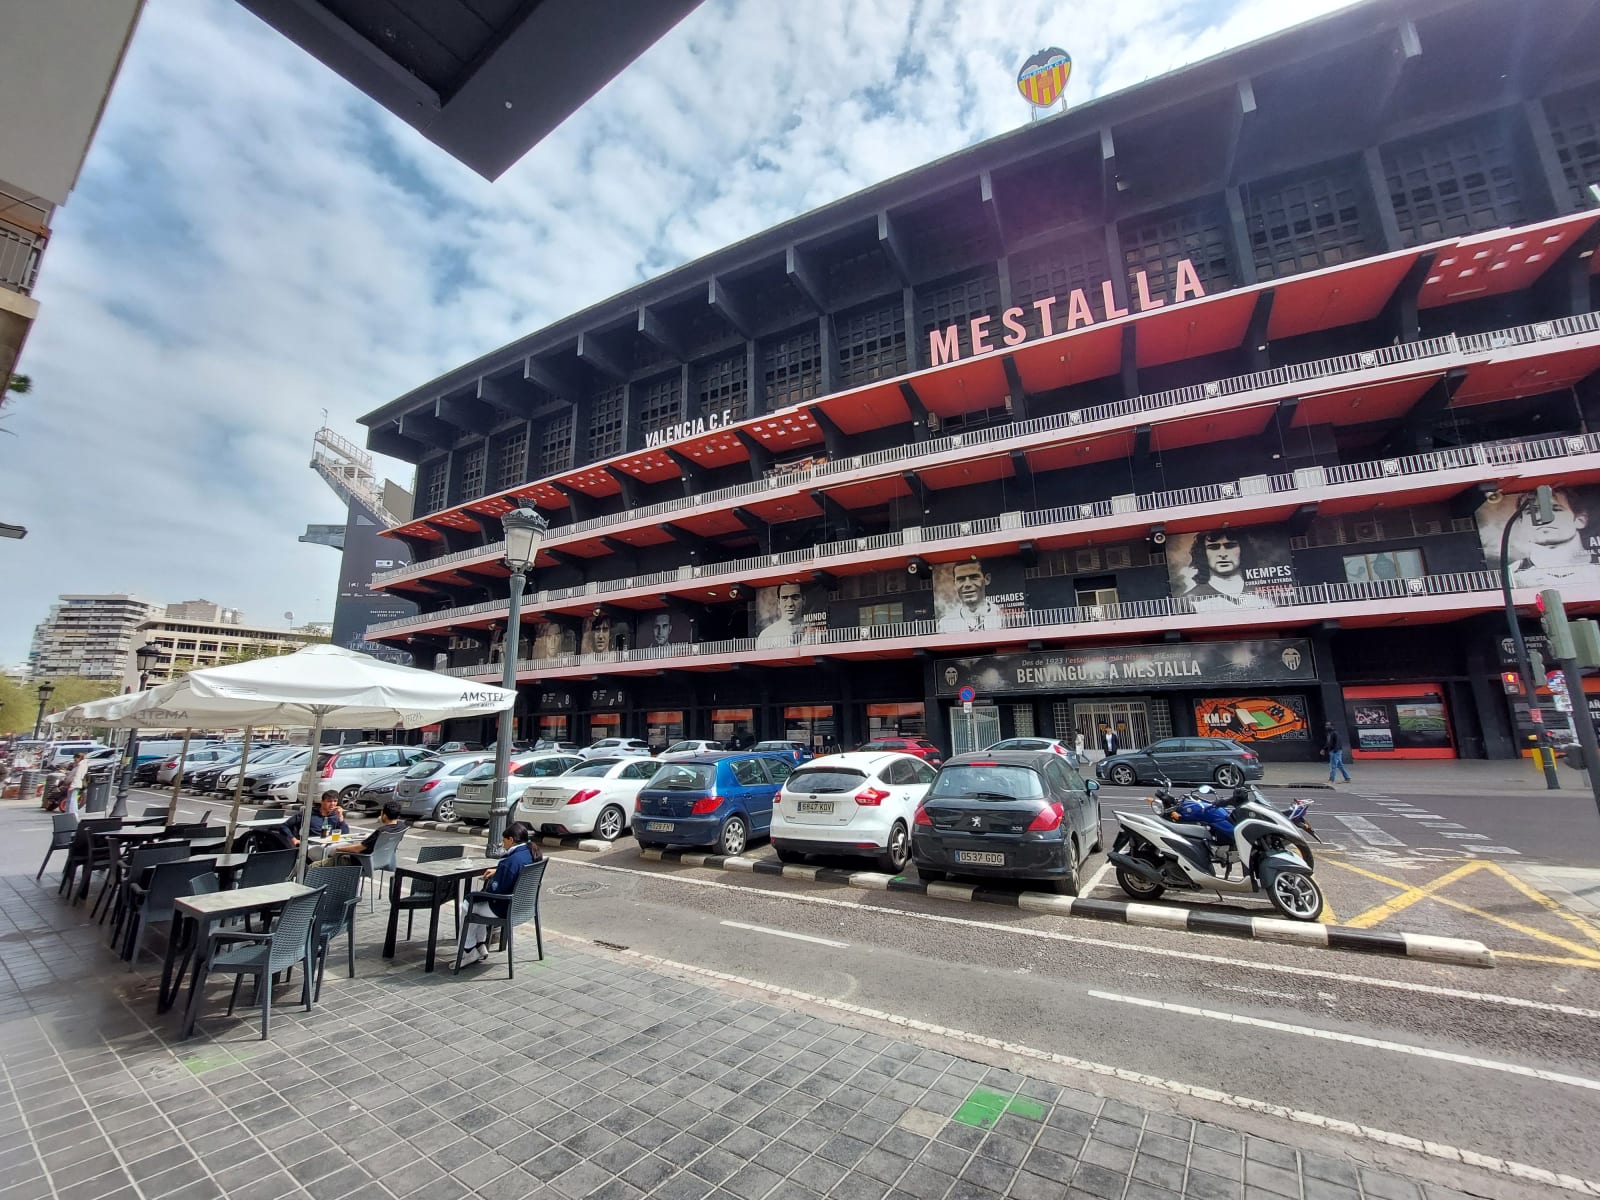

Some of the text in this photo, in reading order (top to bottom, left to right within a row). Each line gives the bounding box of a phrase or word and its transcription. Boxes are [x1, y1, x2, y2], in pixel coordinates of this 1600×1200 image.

[929, 258, 1205, 366] MESTALLA
[645, 409, 734, 448] VALENCIA C.F.
[1245, 565, 1292, 580] KEMPES
[803, 612, 827, 622] MUNDO
[1035, 658, 1043, 666] de
[1045, 657, 1063, 665] 1923
[1016, 660, 1202, 683] BENVINGUTS A MESTALLA
[459, 691, 505, 702] AMSTEL
[960, 851, 1003, 864] 0537 GDG
